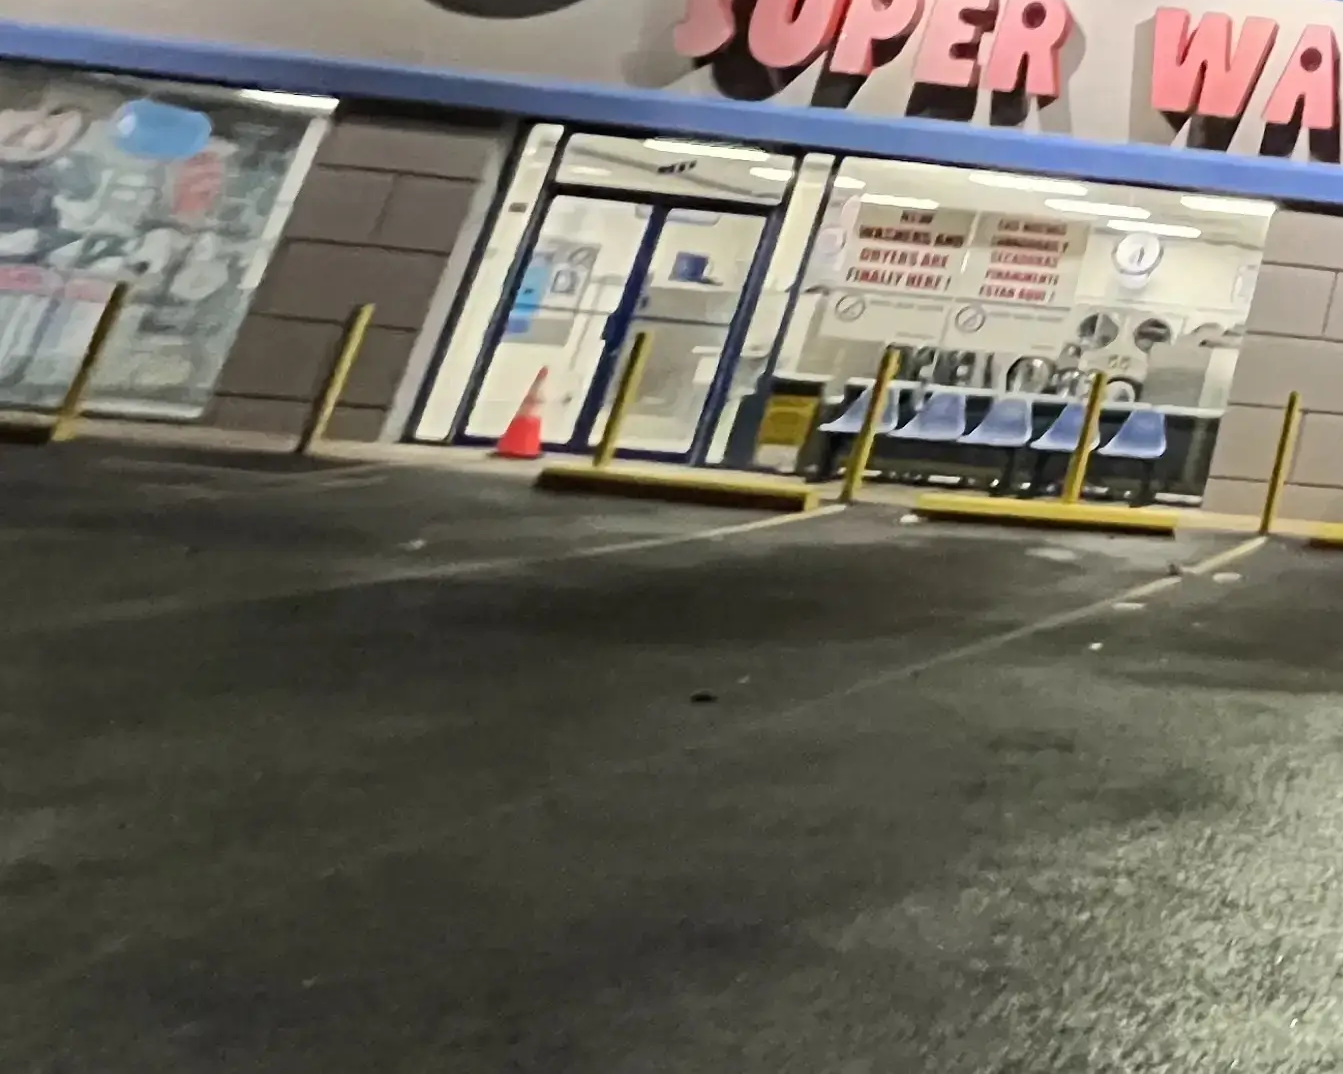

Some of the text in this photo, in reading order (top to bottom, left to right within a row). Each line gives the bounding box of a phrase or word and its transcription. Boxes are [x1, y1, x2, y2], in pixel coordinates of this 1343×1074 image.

[859, 246, 950, 269] DRYERS ARE
[845, 266, 905, 287] FINALLY
